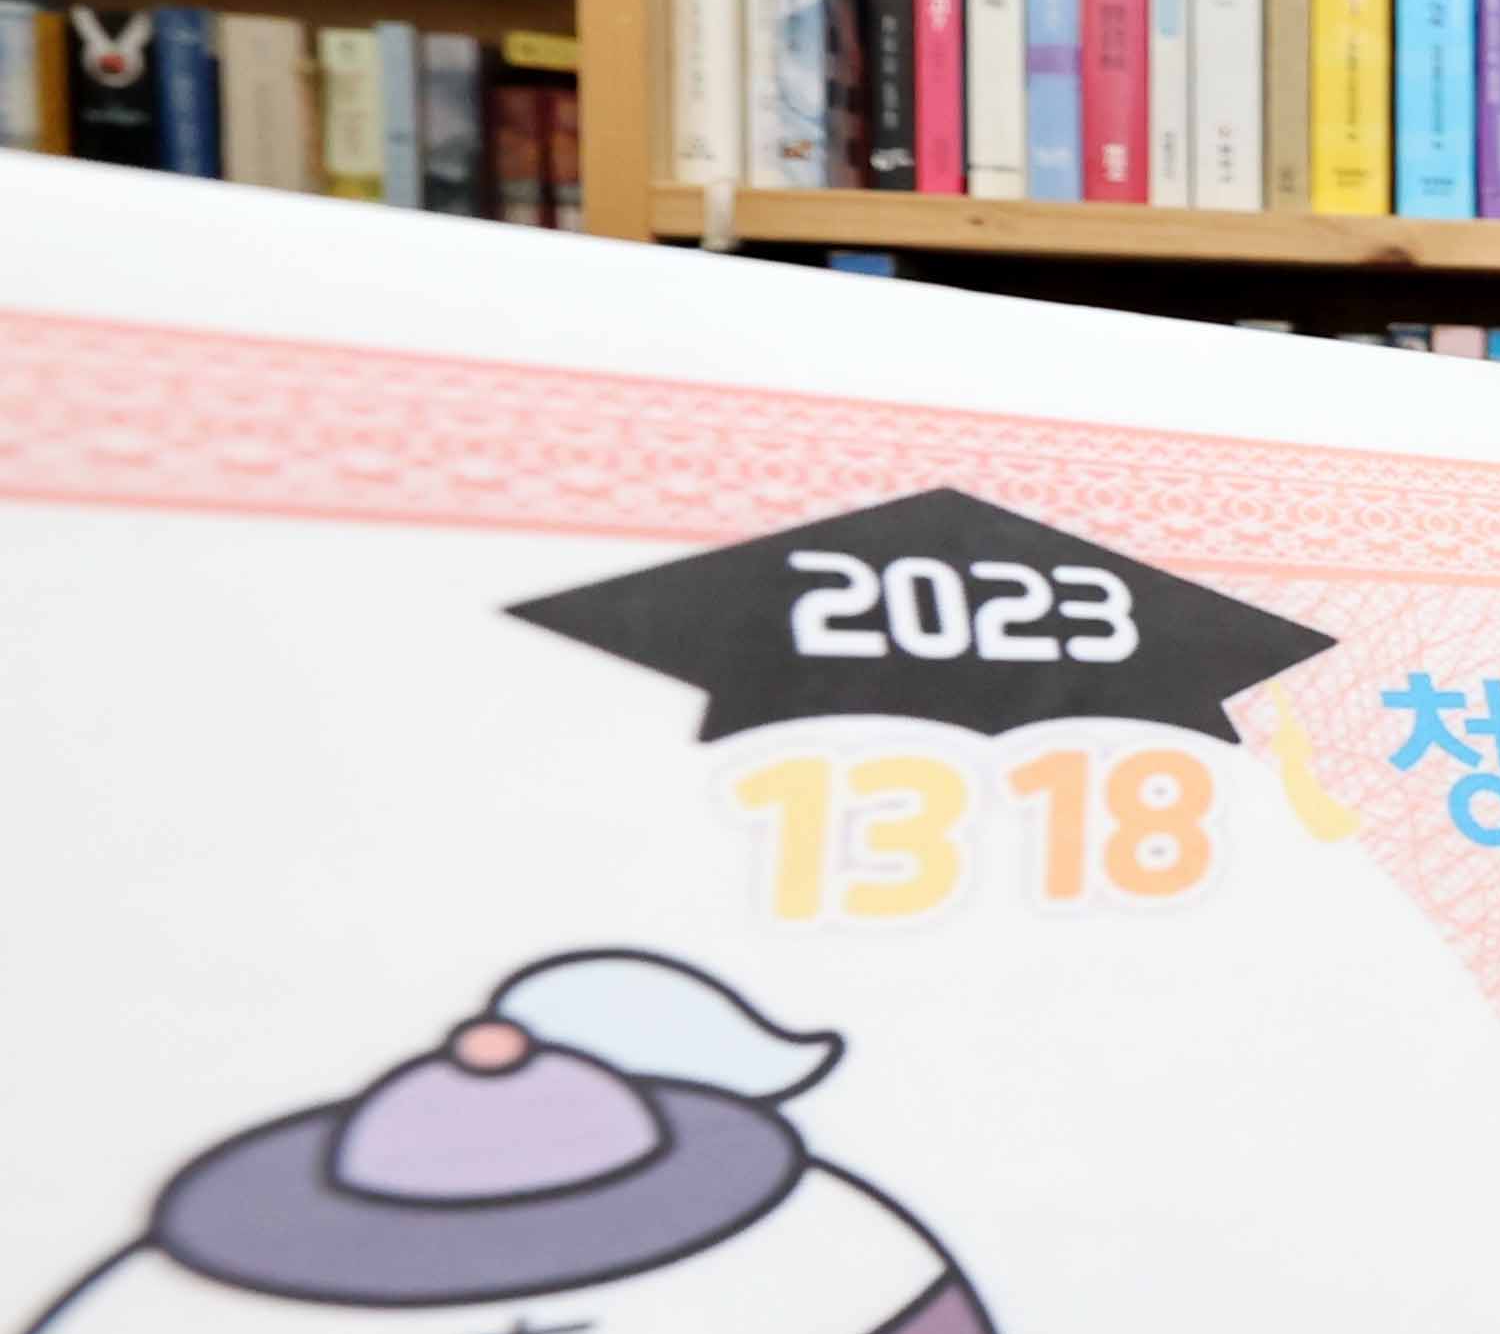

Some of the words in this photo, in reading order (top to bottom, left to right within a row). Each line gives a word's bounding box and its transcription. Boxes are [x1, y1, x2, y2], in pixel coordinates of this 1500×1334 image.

[790, 549, 1141, 663] 2023
[736, 757, 967, 919] 13
[1008, 750, 1213, 899] 18
